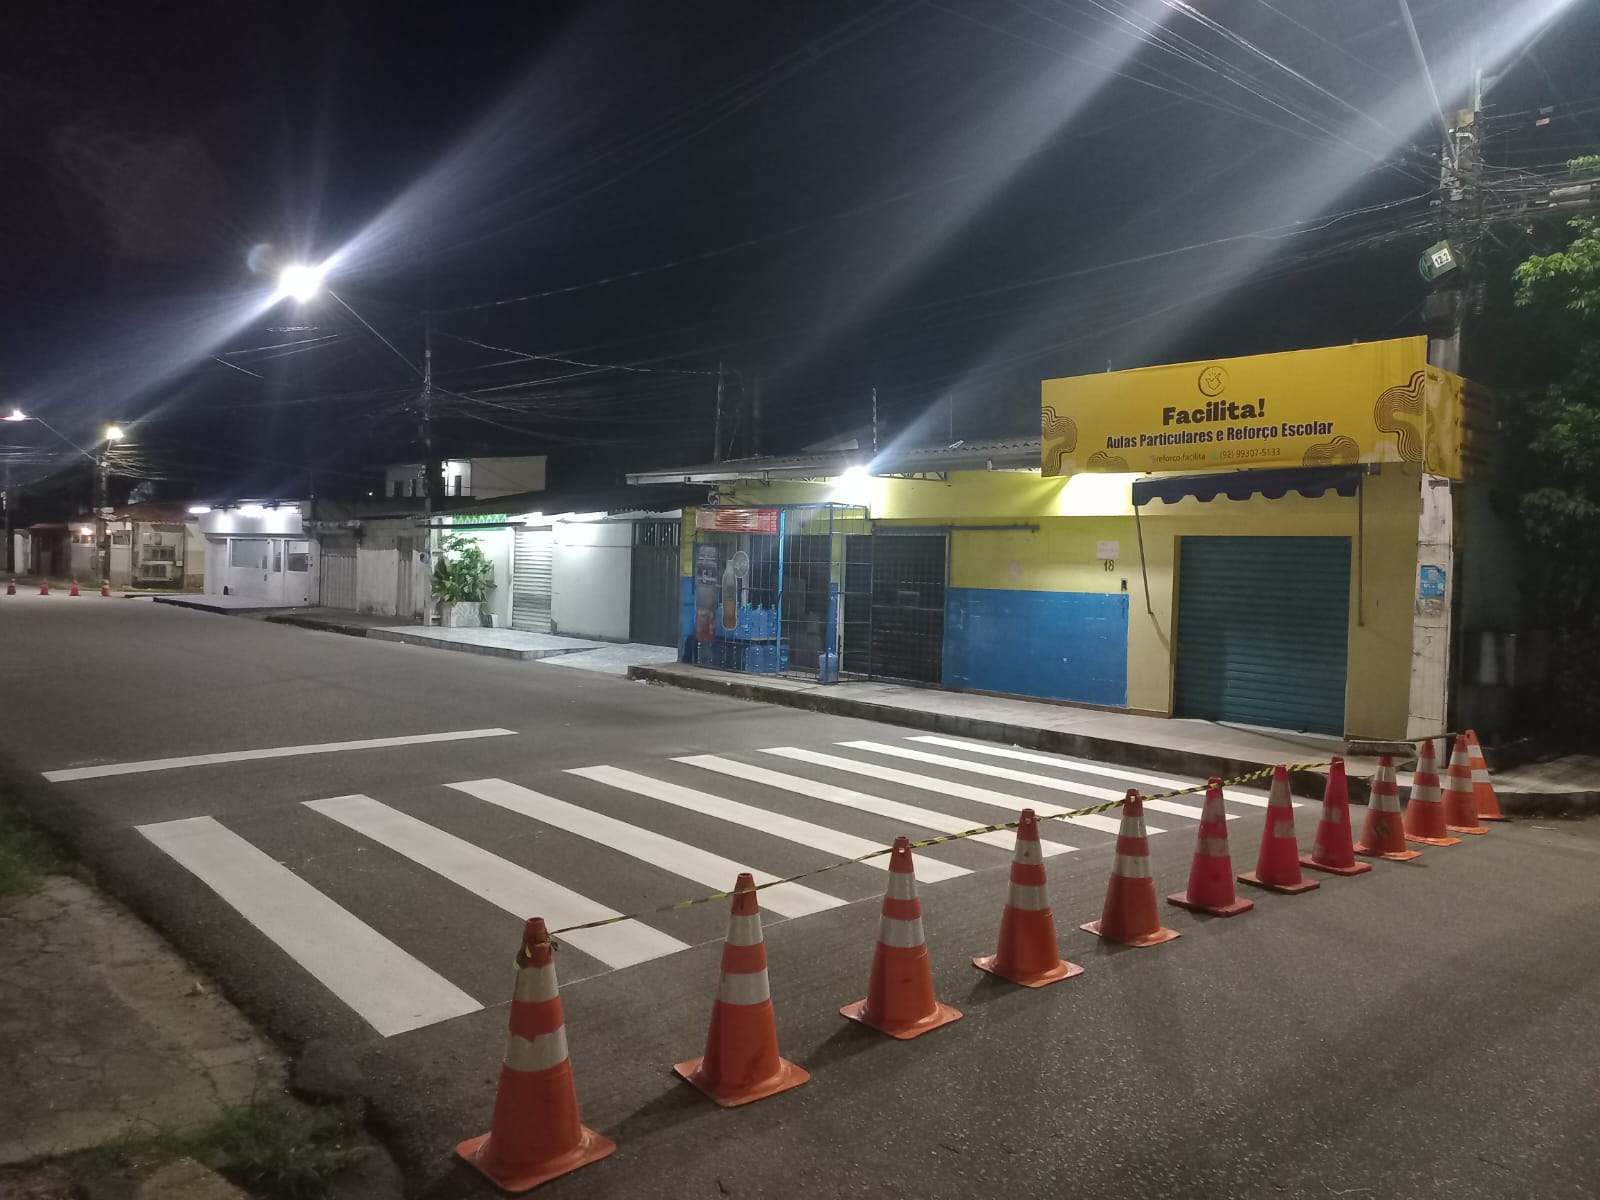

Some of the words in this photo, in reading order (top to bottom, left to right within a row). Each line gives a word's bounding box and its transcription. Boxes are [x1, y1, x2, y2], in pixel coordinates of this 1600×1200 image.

[1162, 398, 1266, 426] Facilita!
[1106, 435, 1137, 449] Aulas
[1140, 430, 1213, 447] Particulares
[1216, 430, 1224, 442] e
[1226, 425, 1279, 442] Reforço
[1281, 420, 1335, 438] Escolar
[1104, 559, 1115, 572] 18
